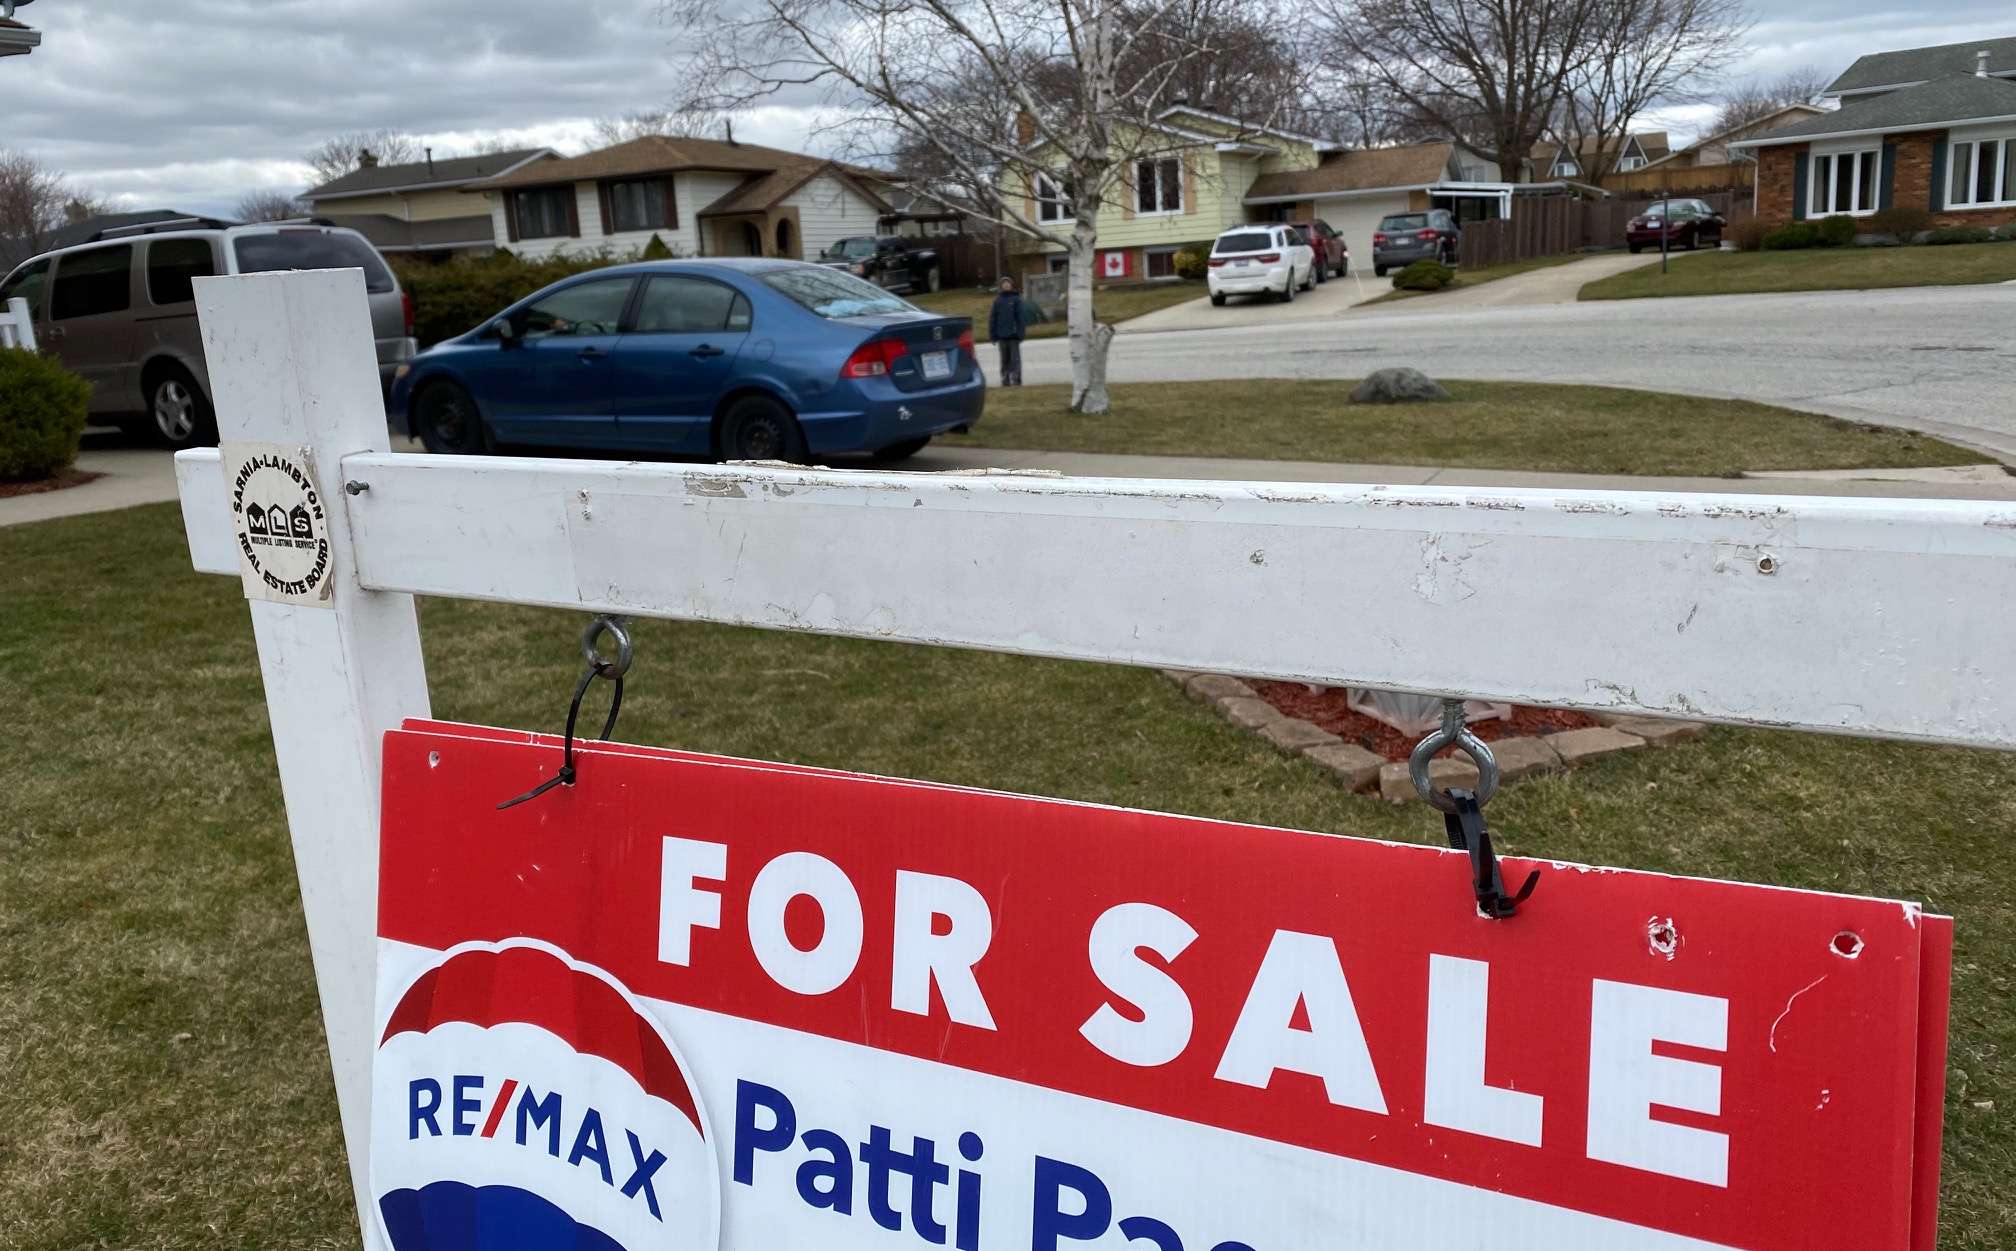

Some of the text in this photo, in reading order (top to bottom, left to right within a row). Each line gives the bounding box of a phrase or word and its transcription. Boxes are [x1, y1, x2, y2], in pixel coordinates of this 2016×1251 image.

[238, 532, 328, 595] REAL ESTATE BOARD
[250, 536, 315, 550] MULTIPLE LISTING SERVICE
[657, 835, 1730, 1188] FOR SALE
[409, 1074, 667, 1223] RE/MAX
[733, 1078, 984, 1251] Patti
